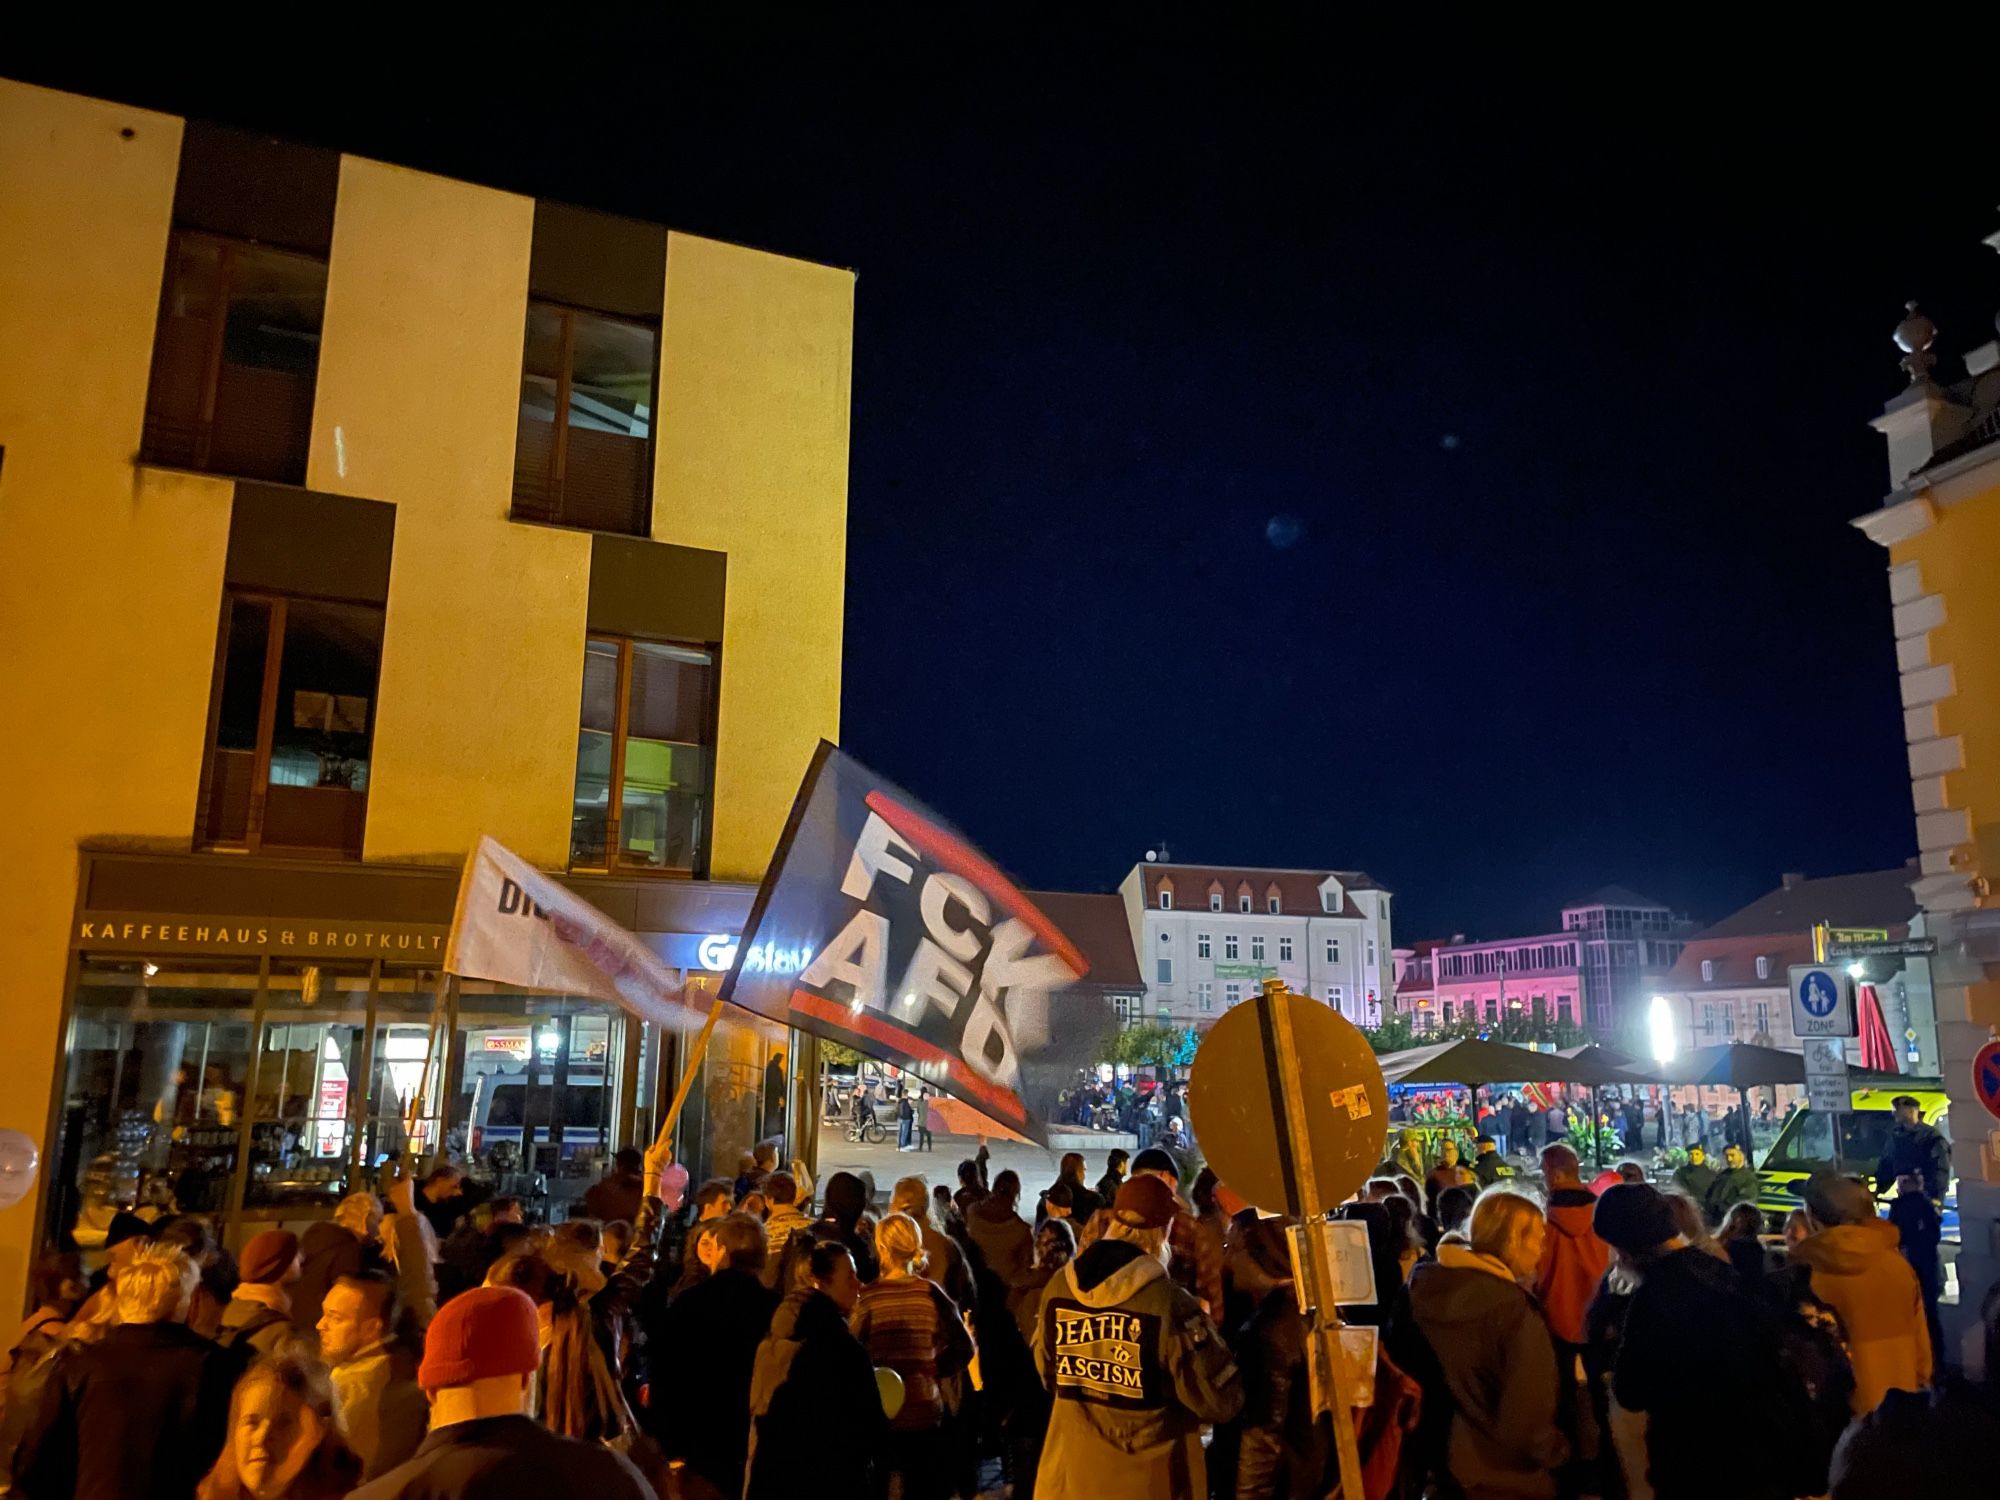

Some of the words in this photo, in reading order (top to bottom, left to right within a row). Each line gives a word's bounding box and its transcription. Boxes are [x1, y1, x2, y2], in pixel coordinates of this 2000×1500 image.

[81, 923, 267, 944] KAFFEEHAUS
[281, 931, 295, 945] &
[840, 810, 1081, 1051] FCK
[1113, 1344, 1131, 1363] to
[1056, 1356, 1143, 1388] ASCISM
